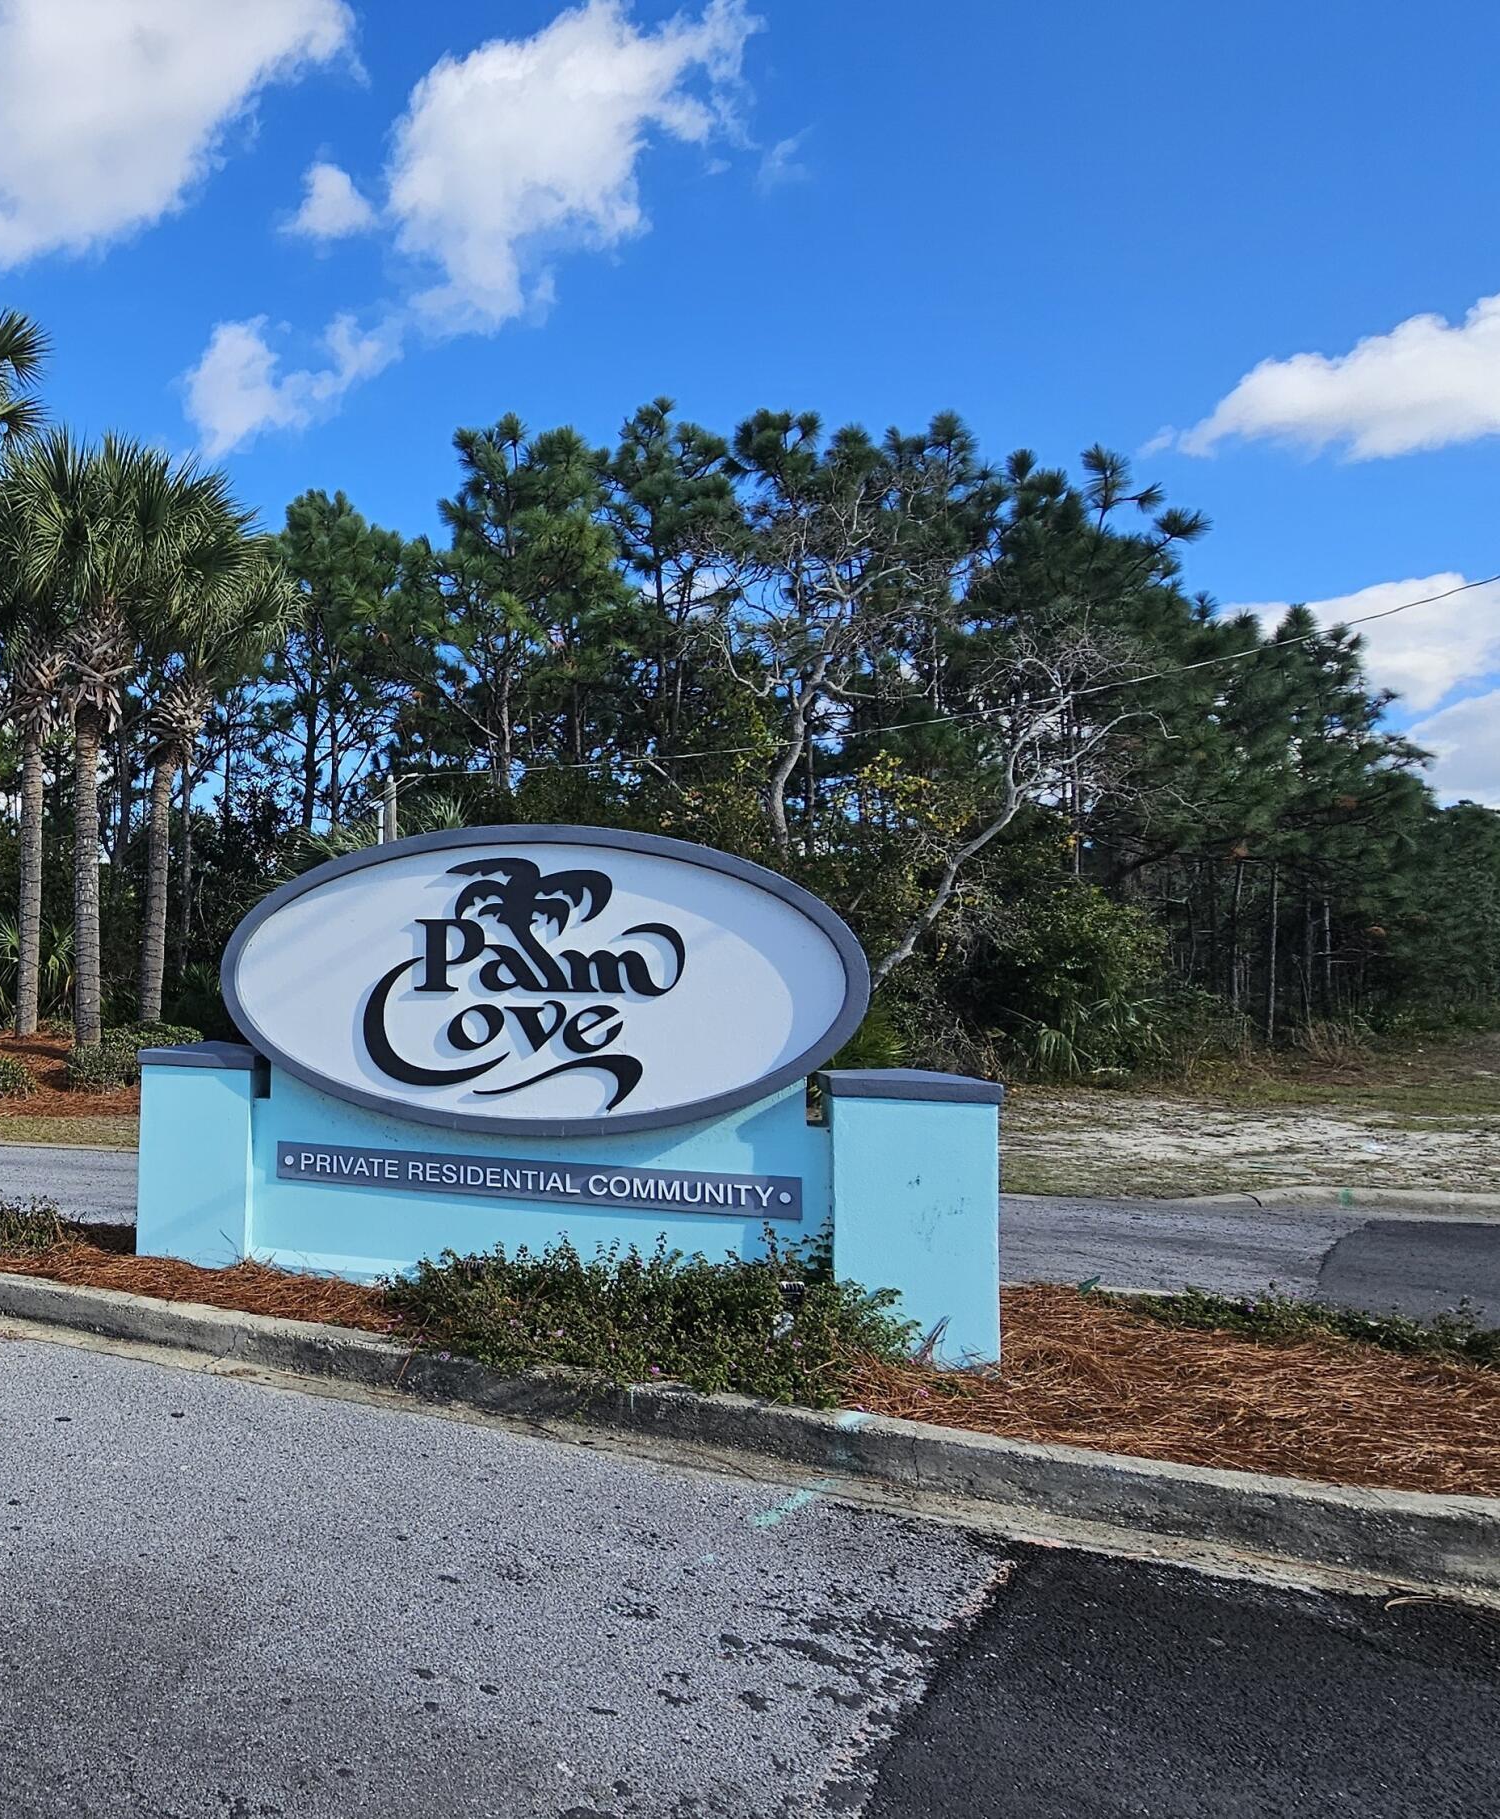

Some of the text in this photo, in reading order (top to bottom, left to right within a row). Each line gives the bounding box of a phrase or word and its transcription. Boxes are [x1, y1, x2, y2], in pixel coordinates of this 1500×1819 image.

[413, 910, 686, 997] Palm
[362, 956, 624, 1086] Cove
[300, 1152, 774, 1207] PRIVATE RESIDENTIAL COMMUNITY
